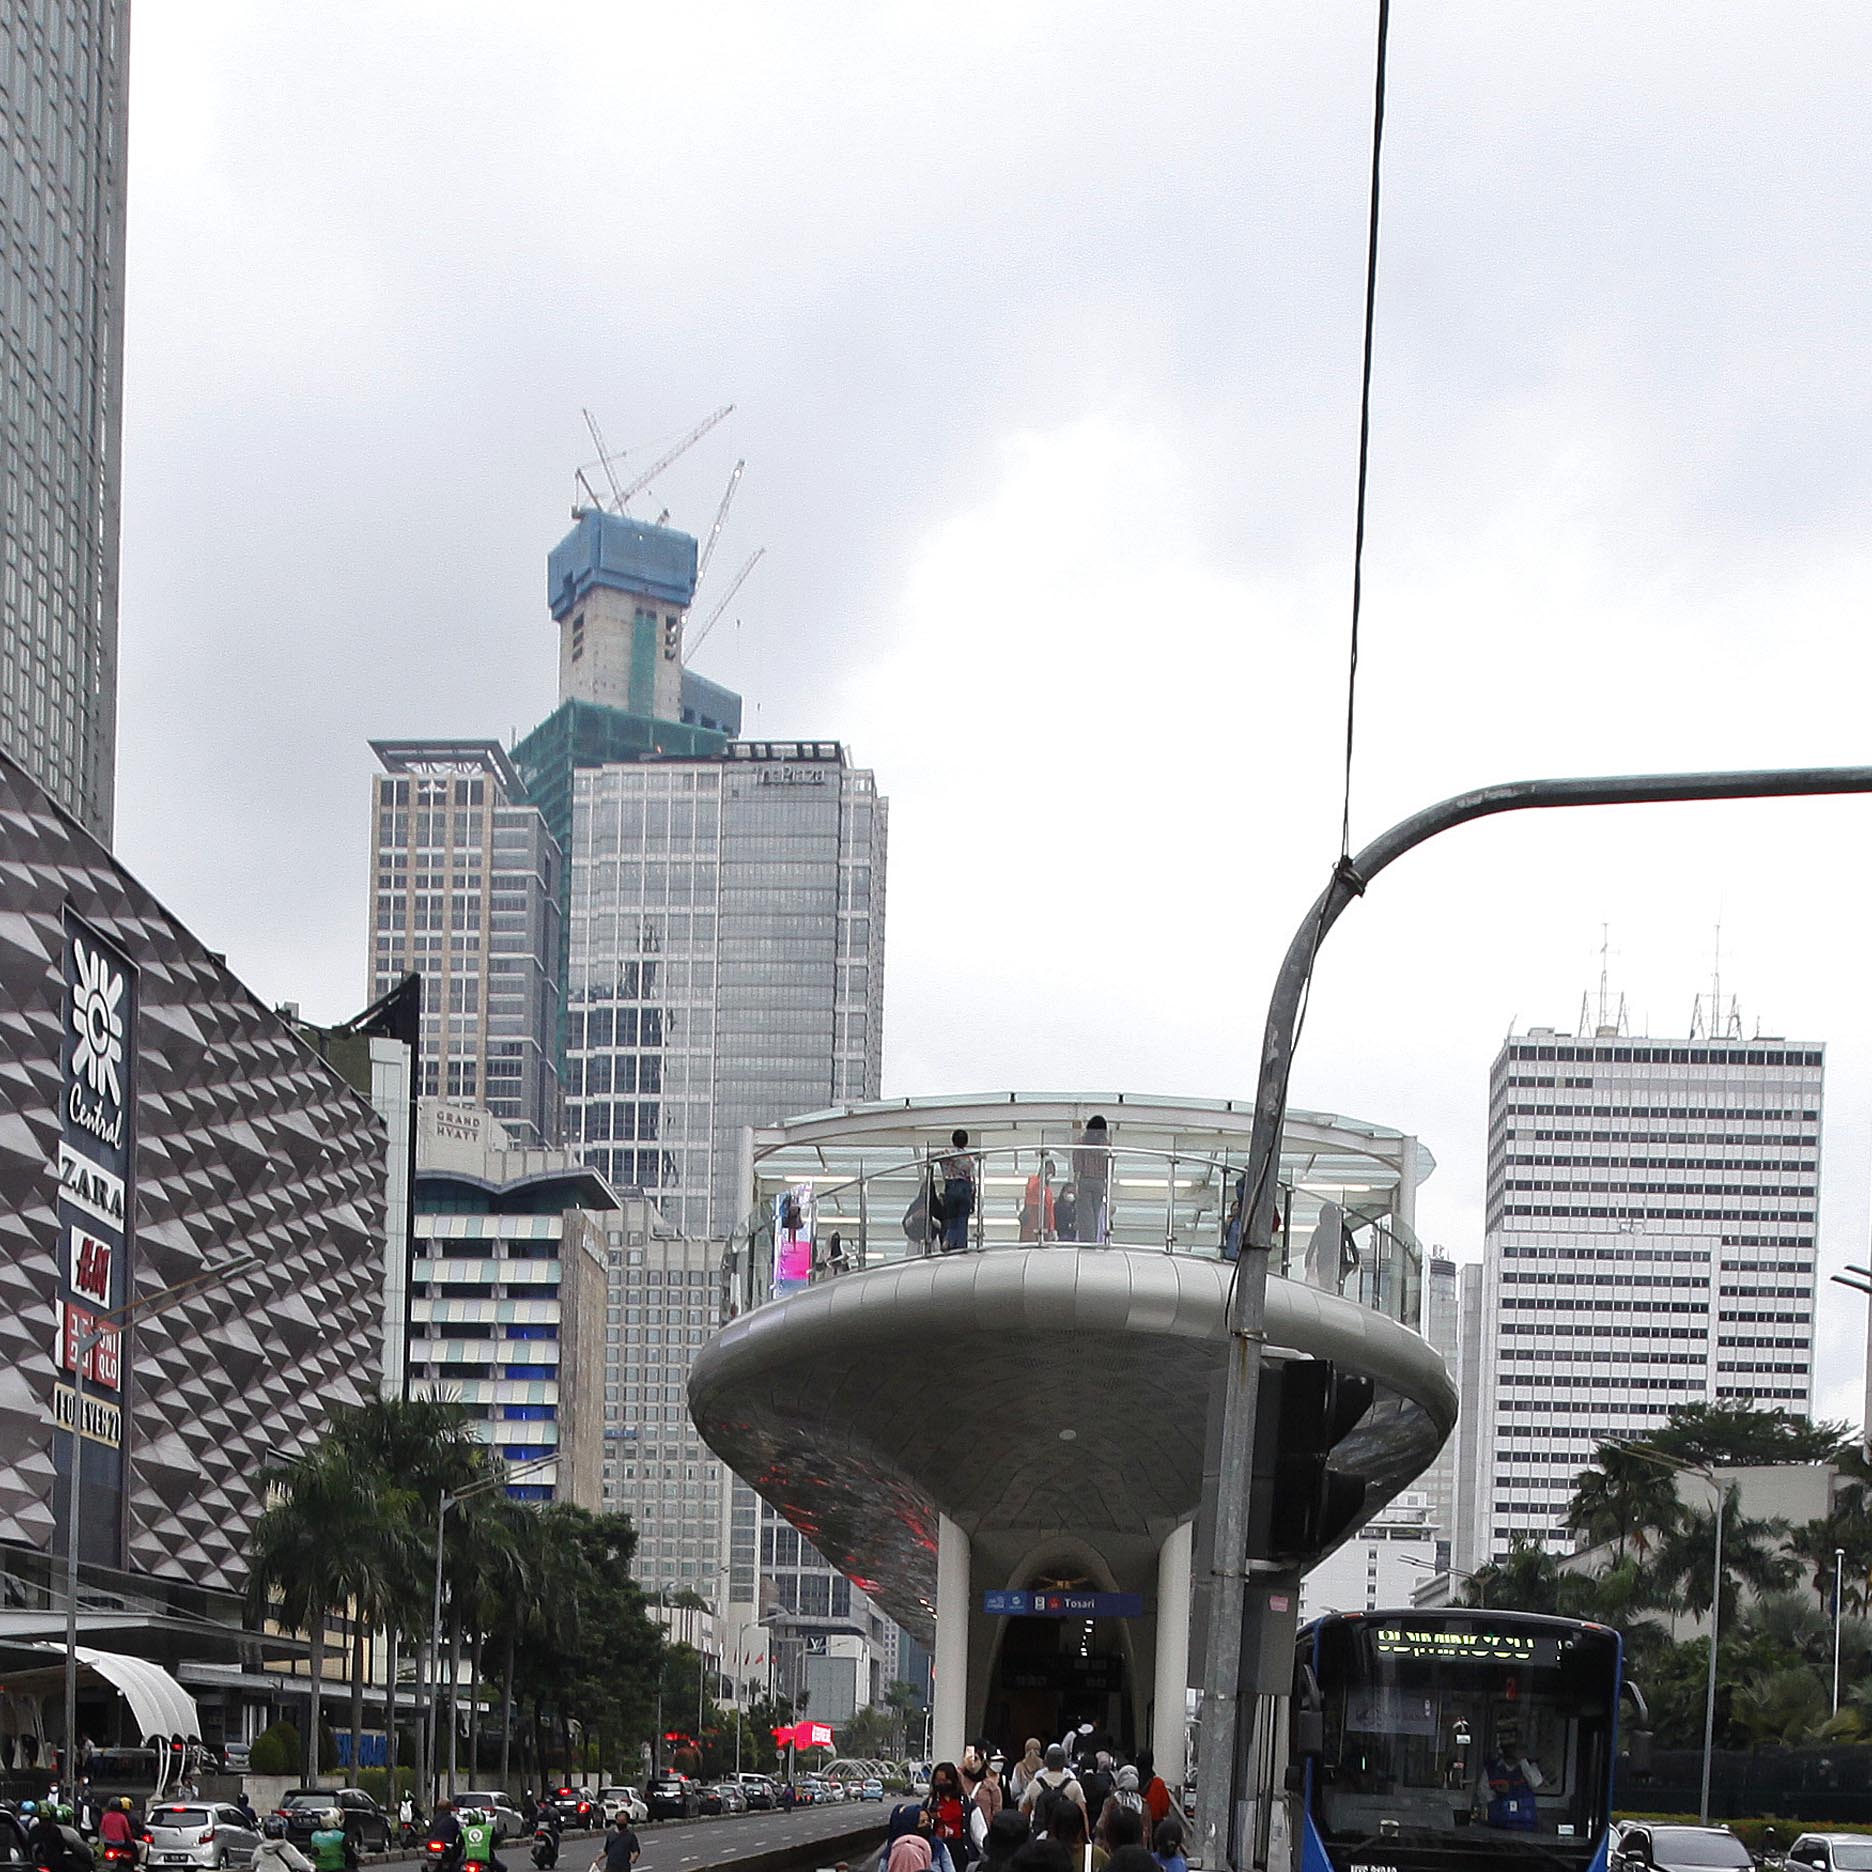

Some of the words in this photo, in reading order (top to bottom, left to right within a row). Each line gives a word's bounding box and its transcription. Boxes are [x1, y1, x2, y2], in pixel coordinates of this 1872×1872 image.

[69, 1082, 122, 1150] Central
[436, 1110, 481, 1127] GRAND
[436, 1126, 480, 1142] HYATT
[61, 1156, 124, 1220] ZARA
[76, 1236, 111, 1301] H&M
[98, 1353, 117, 1380] QLO
[1064, 1598, 1095, 1609] Tosari
